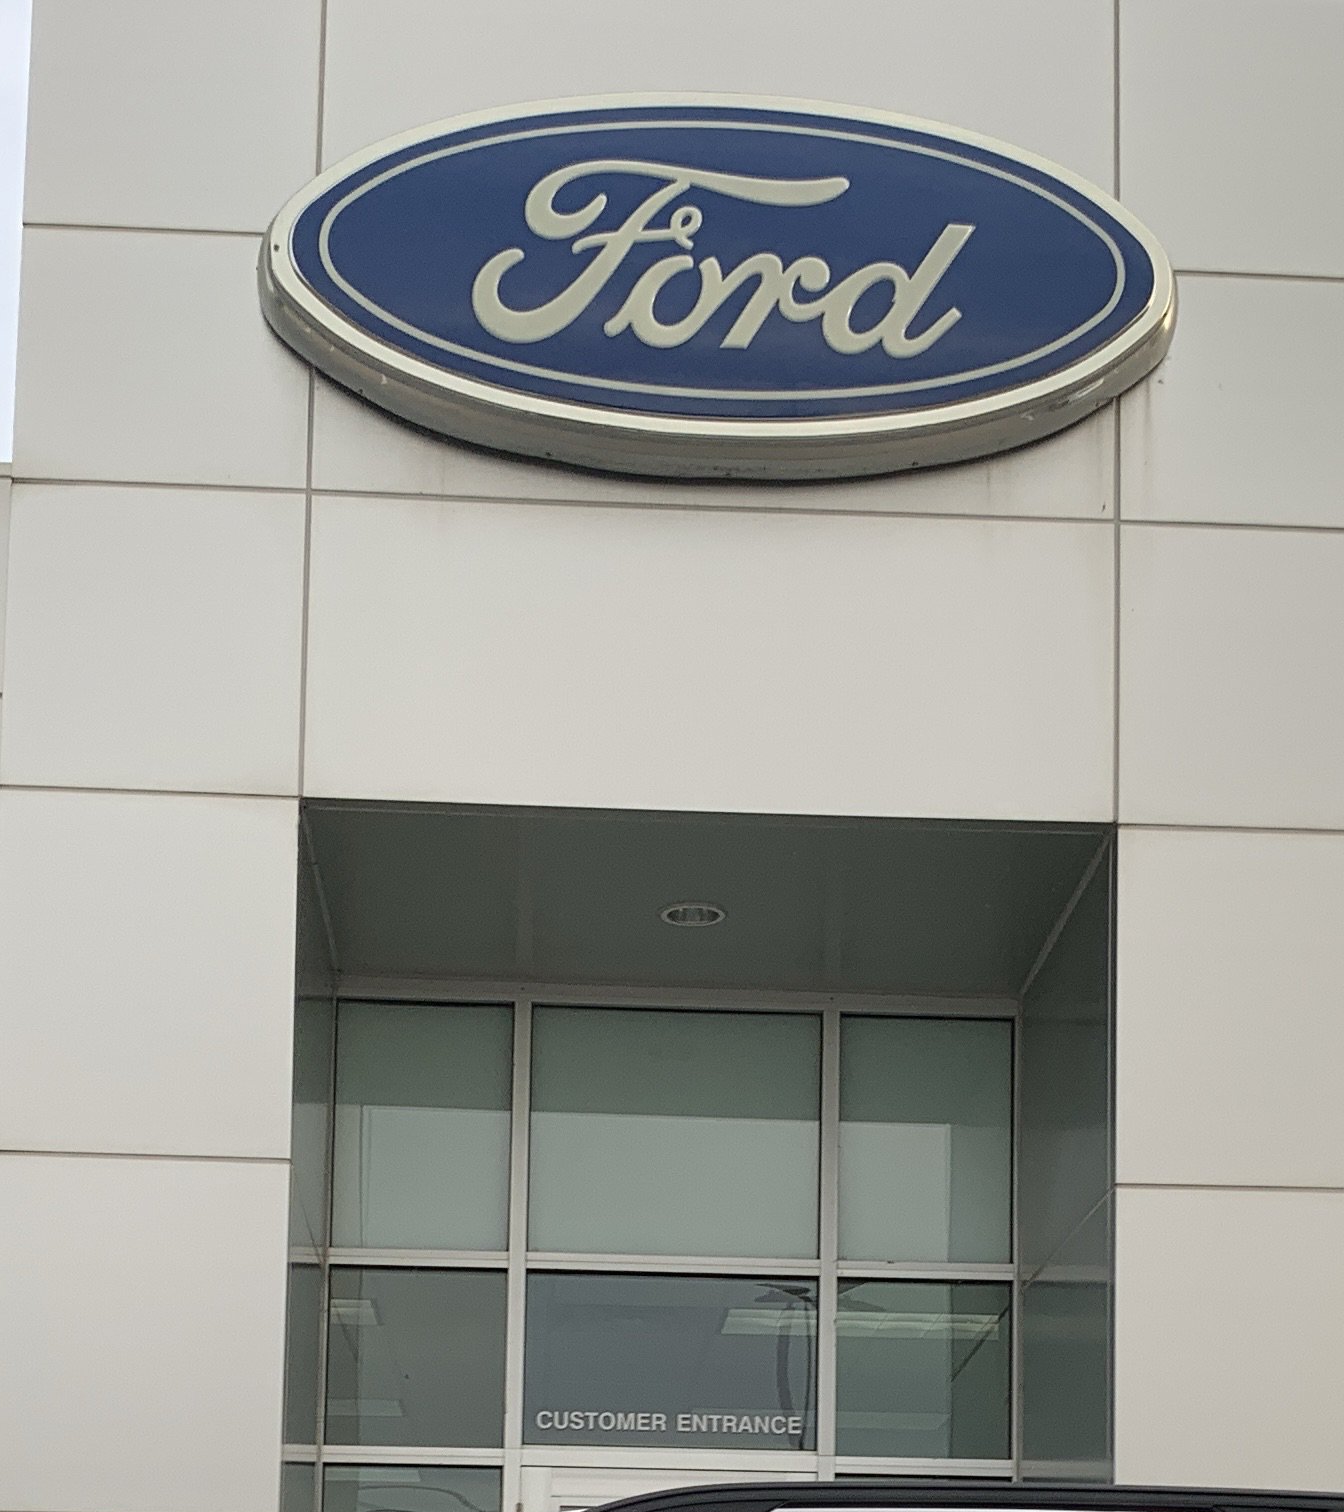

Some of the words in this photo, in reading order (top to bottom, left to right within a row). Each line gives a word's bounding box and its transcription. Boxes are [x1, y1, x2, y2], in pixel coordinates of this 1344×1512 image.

[471, 159, 976, 359] Ford
[535, 1410, 668, 1432] CUSTOMER
[675, 1413, 803, 1435] ENTRANCE
